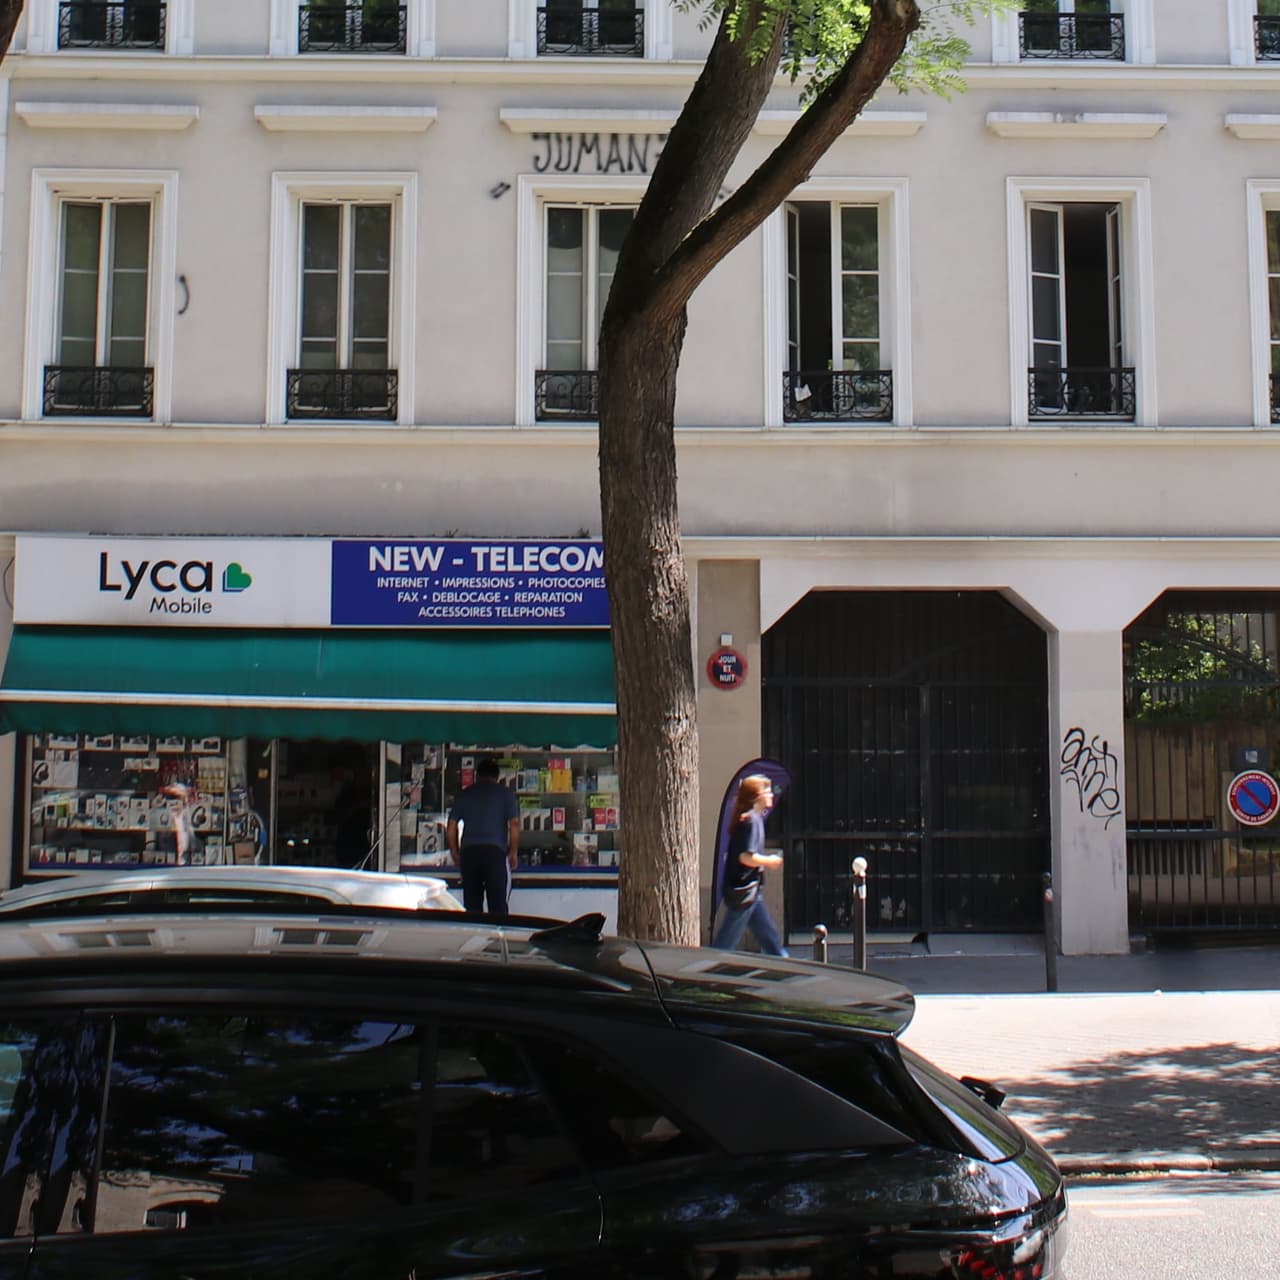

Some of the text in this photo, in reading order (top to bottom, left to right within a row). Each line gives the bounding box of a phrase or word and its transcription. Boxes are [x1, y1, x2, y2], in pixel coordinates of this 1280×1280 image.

[531, 132, 667, 173] JUMAN
[369, 546, 445, 572] NEW
[100, 552, 213, 600] Lyca
[377, 577, 606, 588] INTERNET IMPRESSIONS PHOTOCOPIES
[150, 597, 212, 614] Mobile
[397, 592, 583, 603] FAX DEBLOCAGE REPARATION
[418, 607, 566, 618] ACCESSOIRES TELEPHONES
